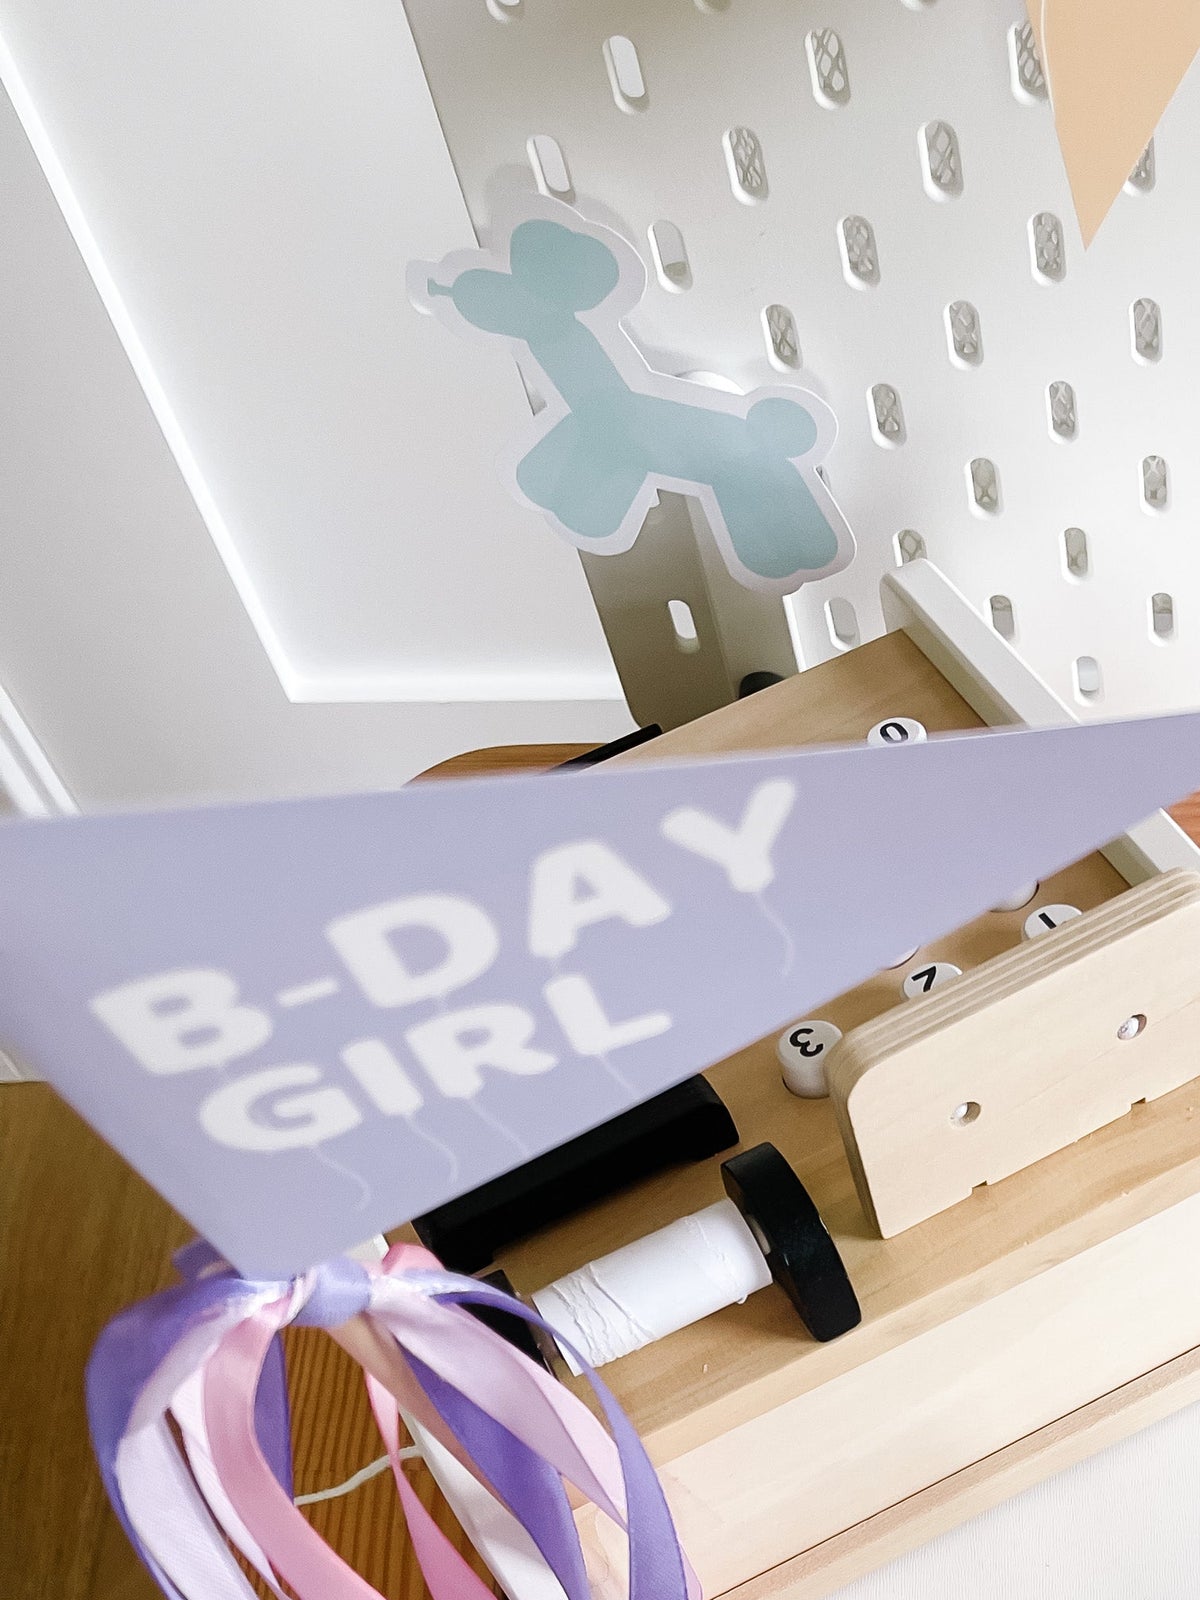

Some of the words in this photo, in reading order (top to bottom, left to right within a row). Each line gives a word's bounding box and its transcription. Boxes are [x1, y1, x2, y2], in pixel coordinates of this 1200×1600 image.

[88, 777, 797, 1076] B-DAY
[199, 972, 672, 1152] GIRL
[789, 1028, 824, 1058] 3
